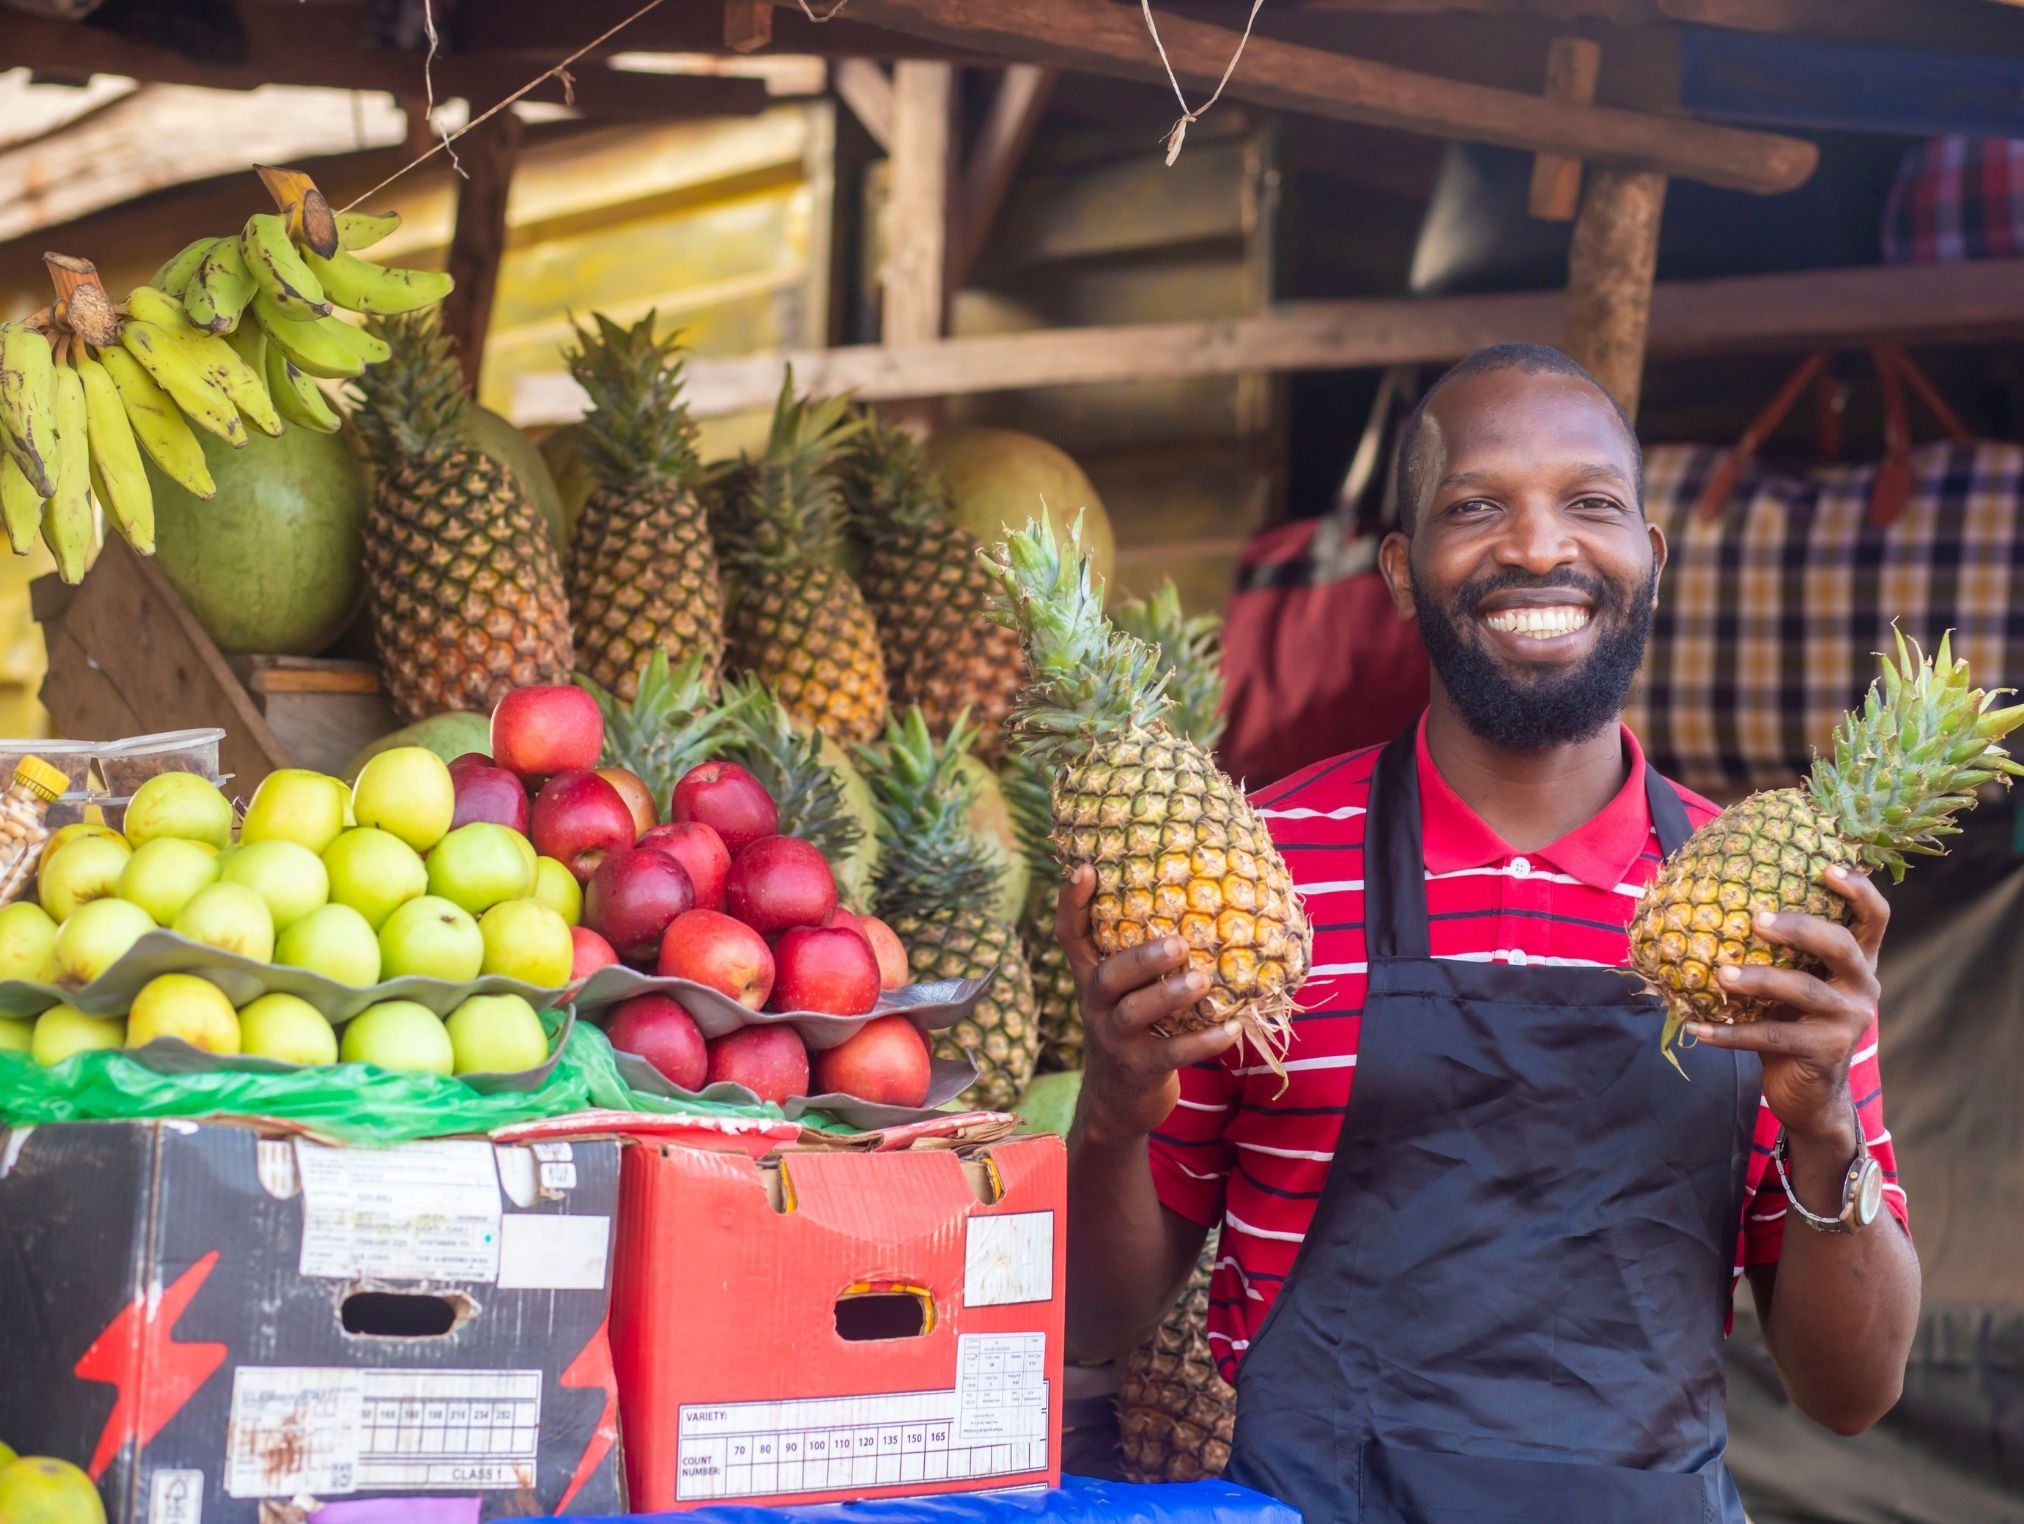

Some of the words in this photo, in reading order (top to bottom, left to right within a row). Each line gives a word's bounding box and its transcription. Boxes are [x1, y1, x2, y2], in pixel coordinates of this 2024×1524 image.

[474, 1410, 489, 1419] 234
[686, 1411, 727, 1422] VARIETY:
[734, 1446, 745, 1456] 70
[760, 1444, 771, 1454] 80
[785, 1442, 797, 1452] 90
[809, 1441, 825, 1450] 100
[835, 1439, 850, 1449] 110
[859, 1437, 874, 1447] 120
[883, 1435, 898, 1445] 135
[907, 1433, 922, 1444] 150
[930, 1432, 946, 1442] 165
[682, 1456, 712, 1465] COUNT
[453, 1468, 492, 1480] CLASS
[682, 1466, 721, 1476] NUMBER:
